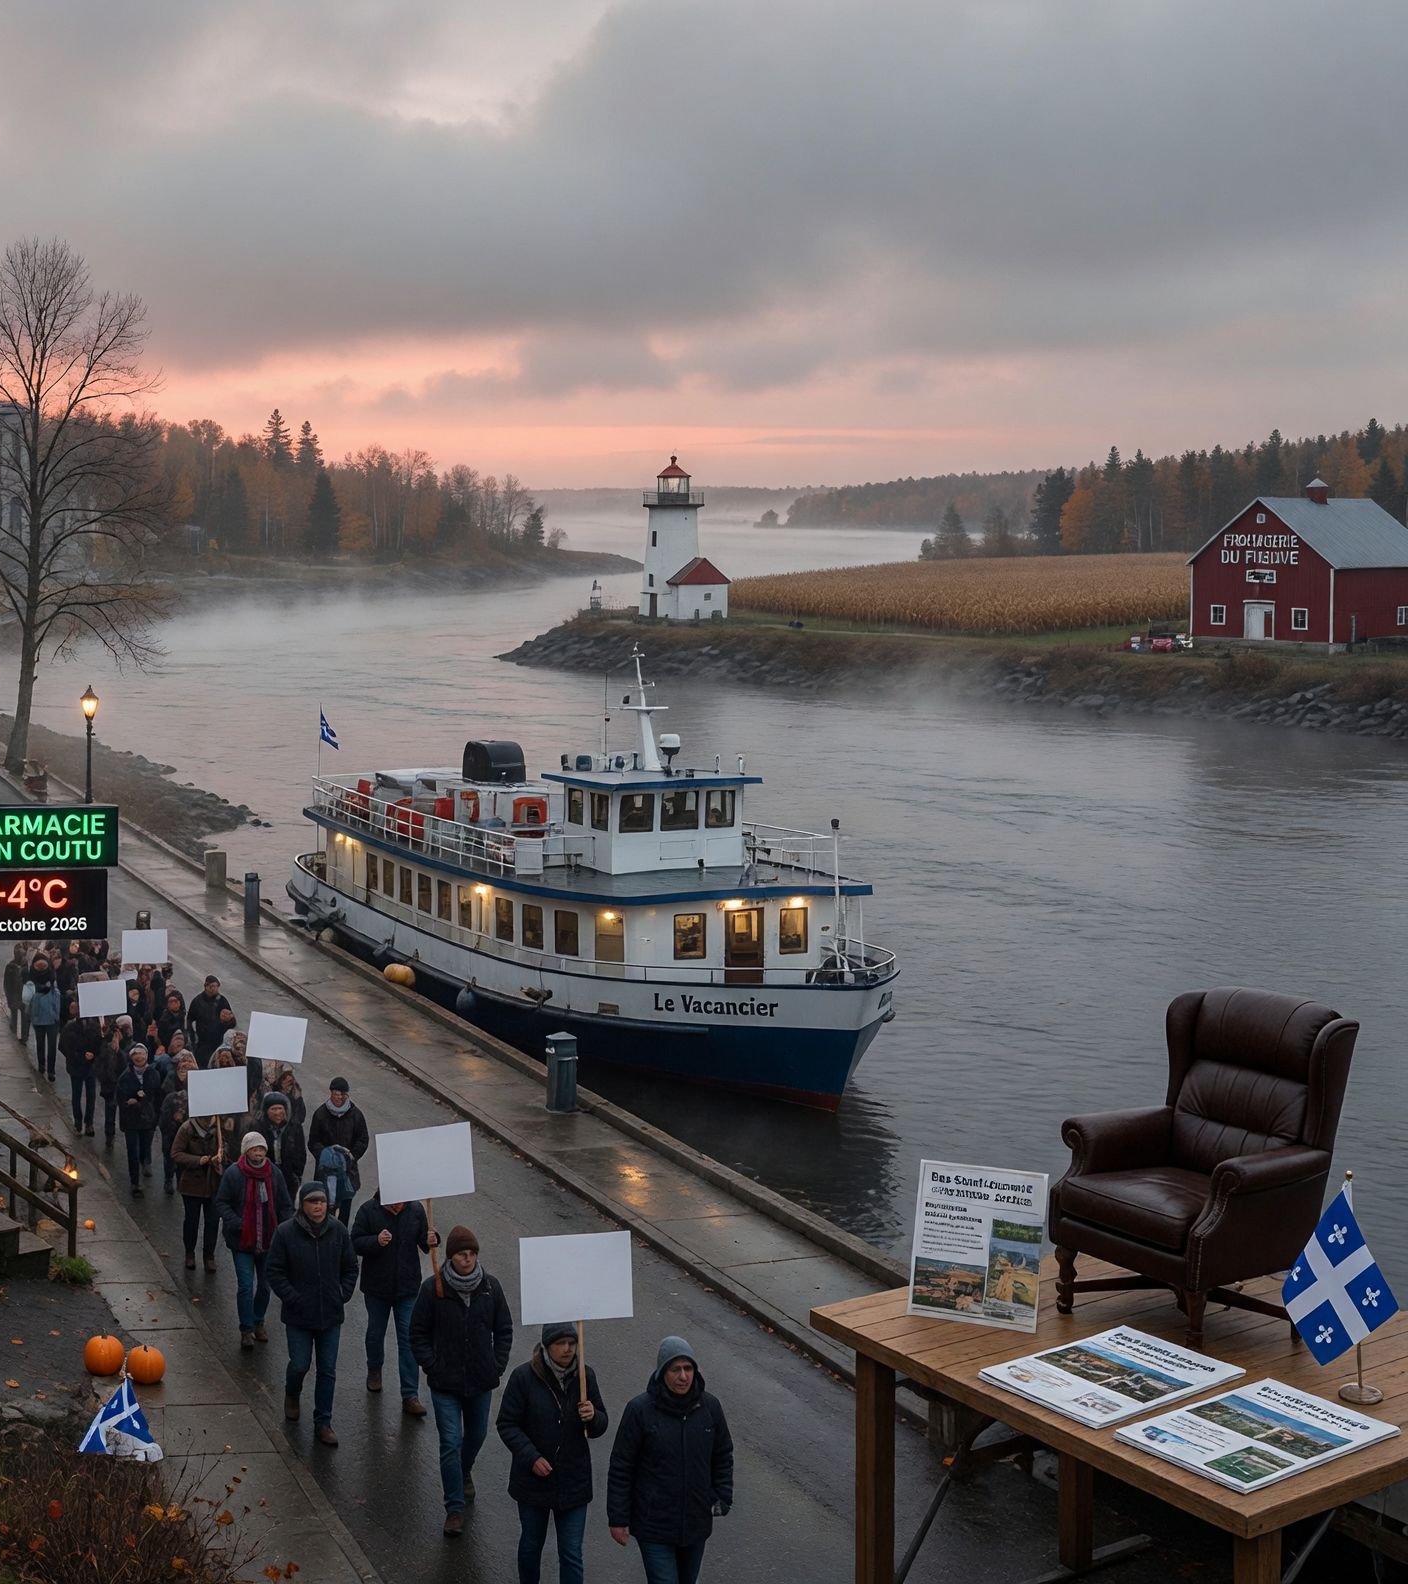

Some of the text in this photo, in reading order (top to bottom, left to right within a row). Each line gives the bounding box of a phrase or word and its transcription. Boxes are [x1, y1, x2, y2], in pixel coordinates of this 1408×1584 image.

[1221, 550, 1240, 564] DU
[20, 840, 102, 861] COUTU
[50, 917, 88, 931] 2026
[654, 993, 779, 1017] Le Vacancier
